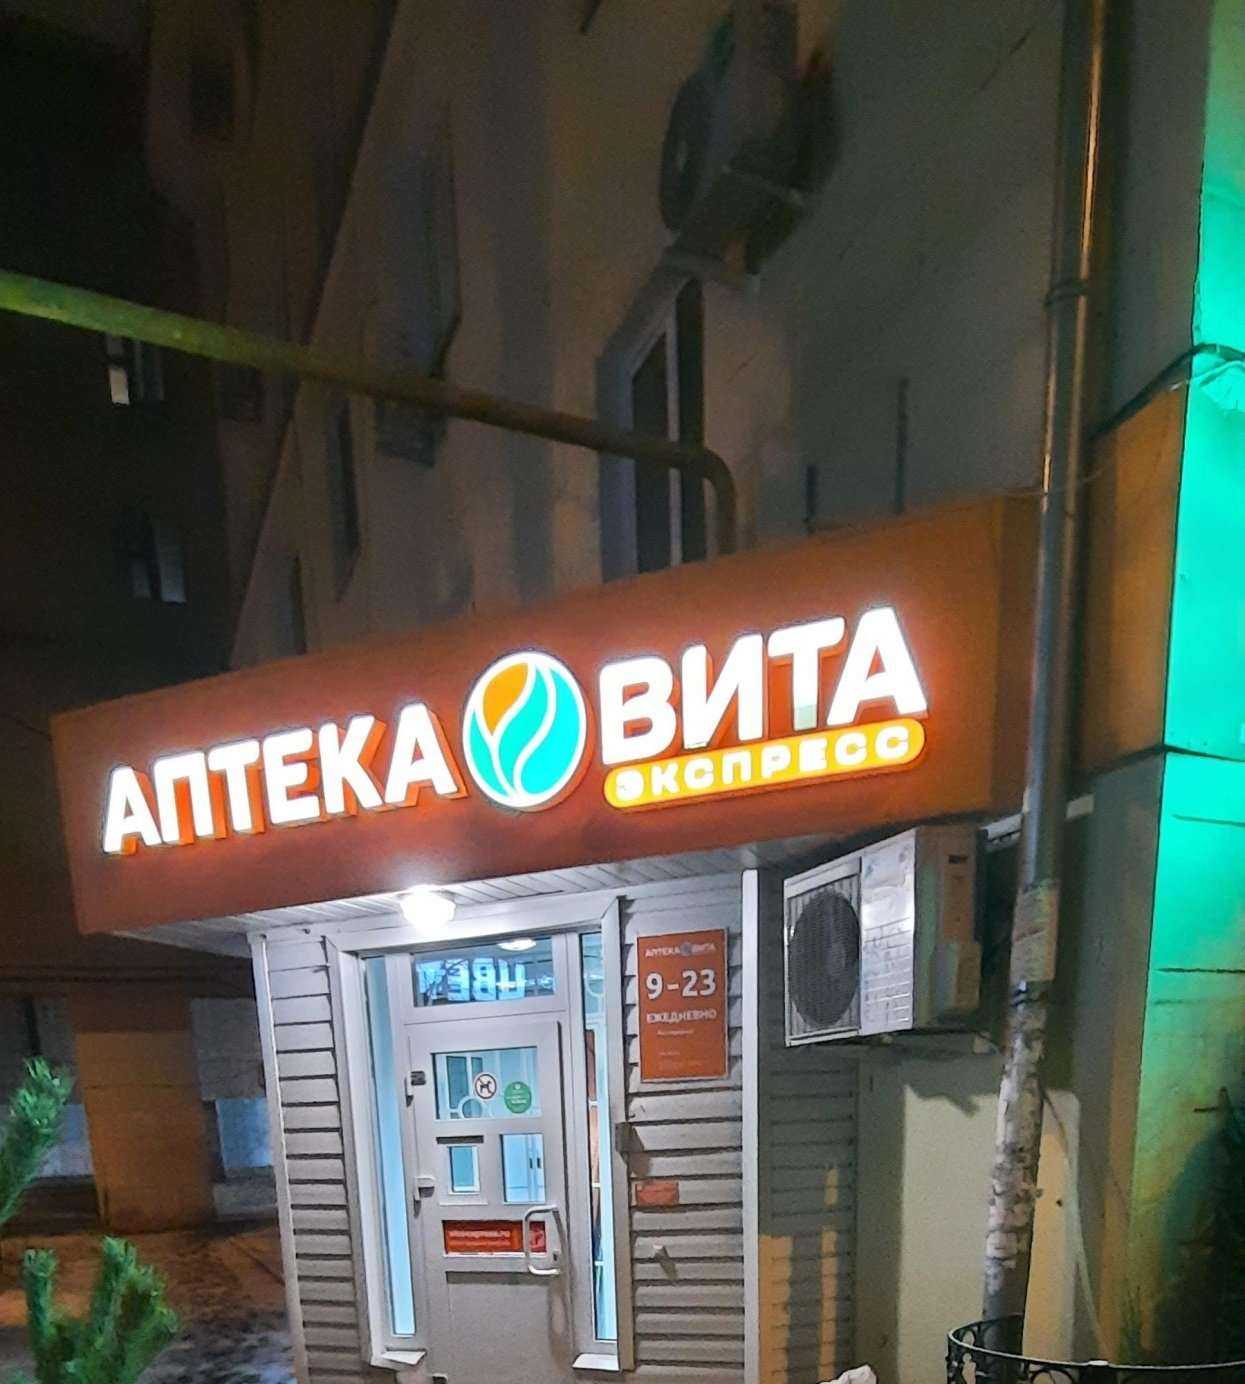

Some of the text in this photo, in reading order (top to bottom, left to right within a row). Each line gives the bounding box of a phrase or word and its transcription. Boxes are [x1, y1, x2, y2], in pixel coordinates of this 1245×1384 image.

[103, 606, 928, 854] АПТЕКА ВИТА
[614, 725, 911, 802] ЭКСПРЕСС
[645, 946, 681, 958] АПТЕКА
[646, 1010, 718, 1024] ЕЖЕДНЕВНО
